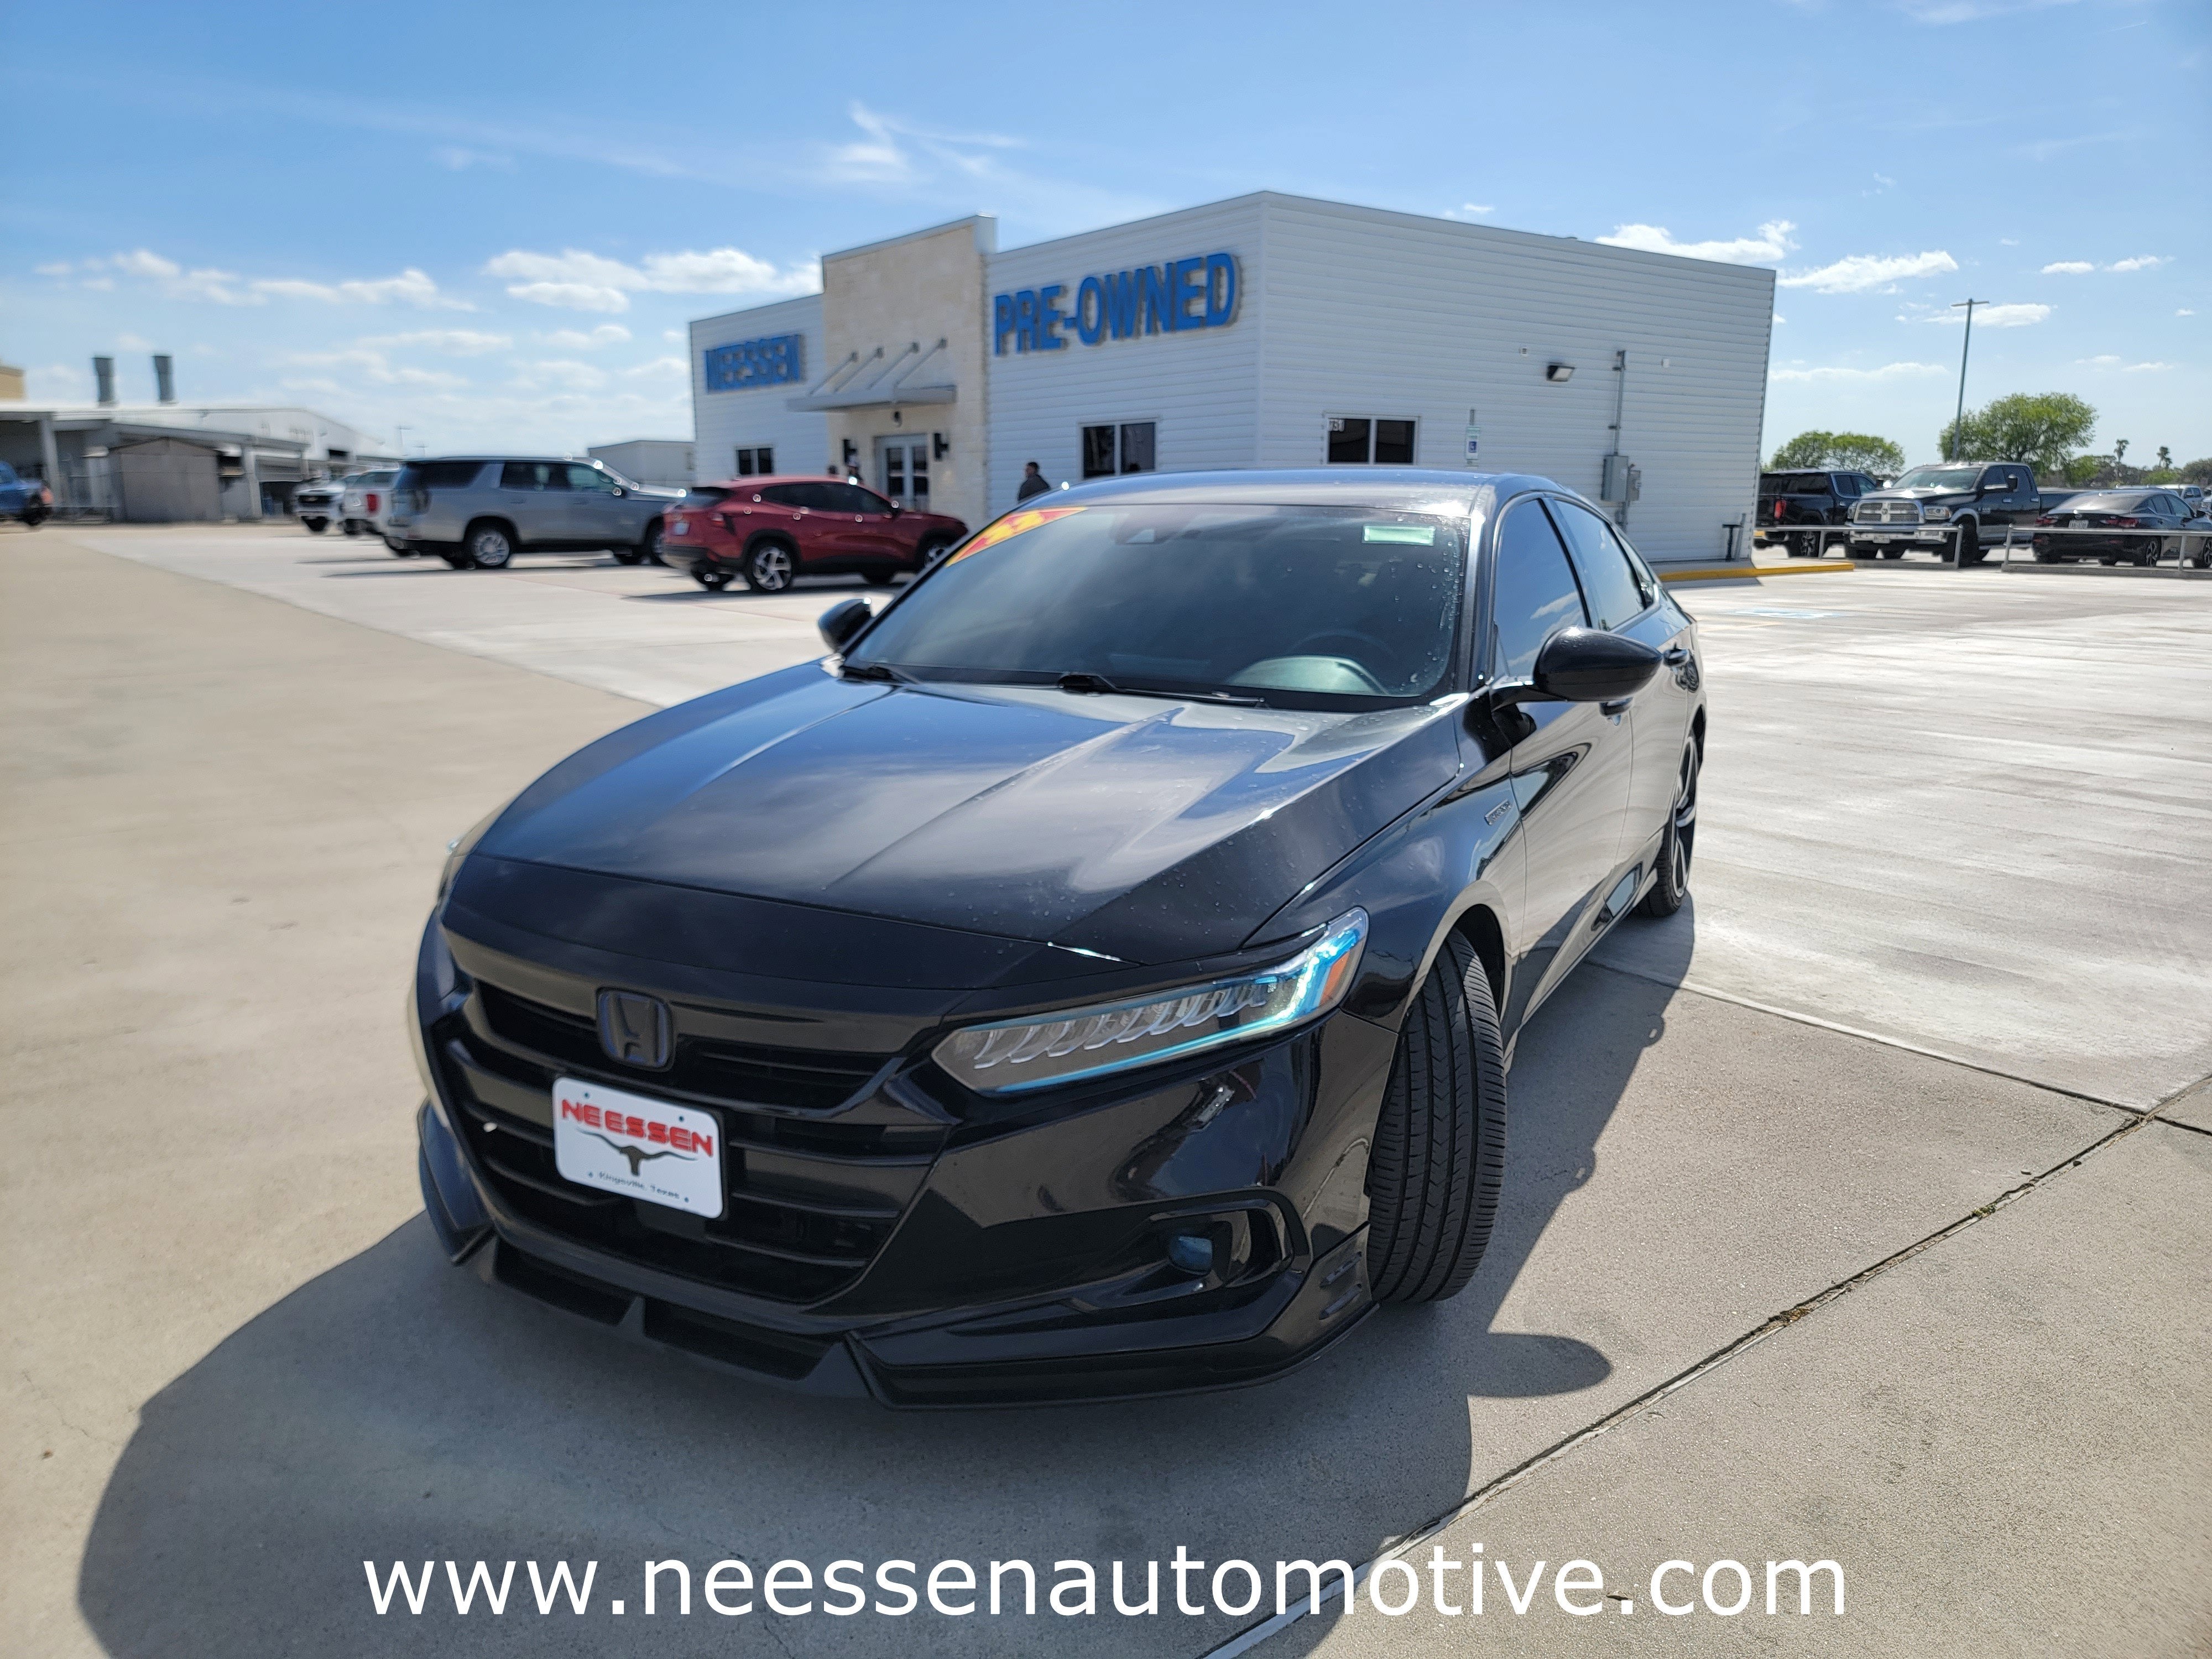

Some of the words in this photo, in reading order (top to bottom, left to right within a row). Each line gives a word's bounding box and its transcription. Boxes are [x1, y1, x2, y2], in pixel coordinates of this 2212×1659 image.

[994, 253, 1238, 357] PRE-OWNED
[705, 335, 802, 394] NEESSEN
[562, 1099, 713, 1157] NEESSEN
